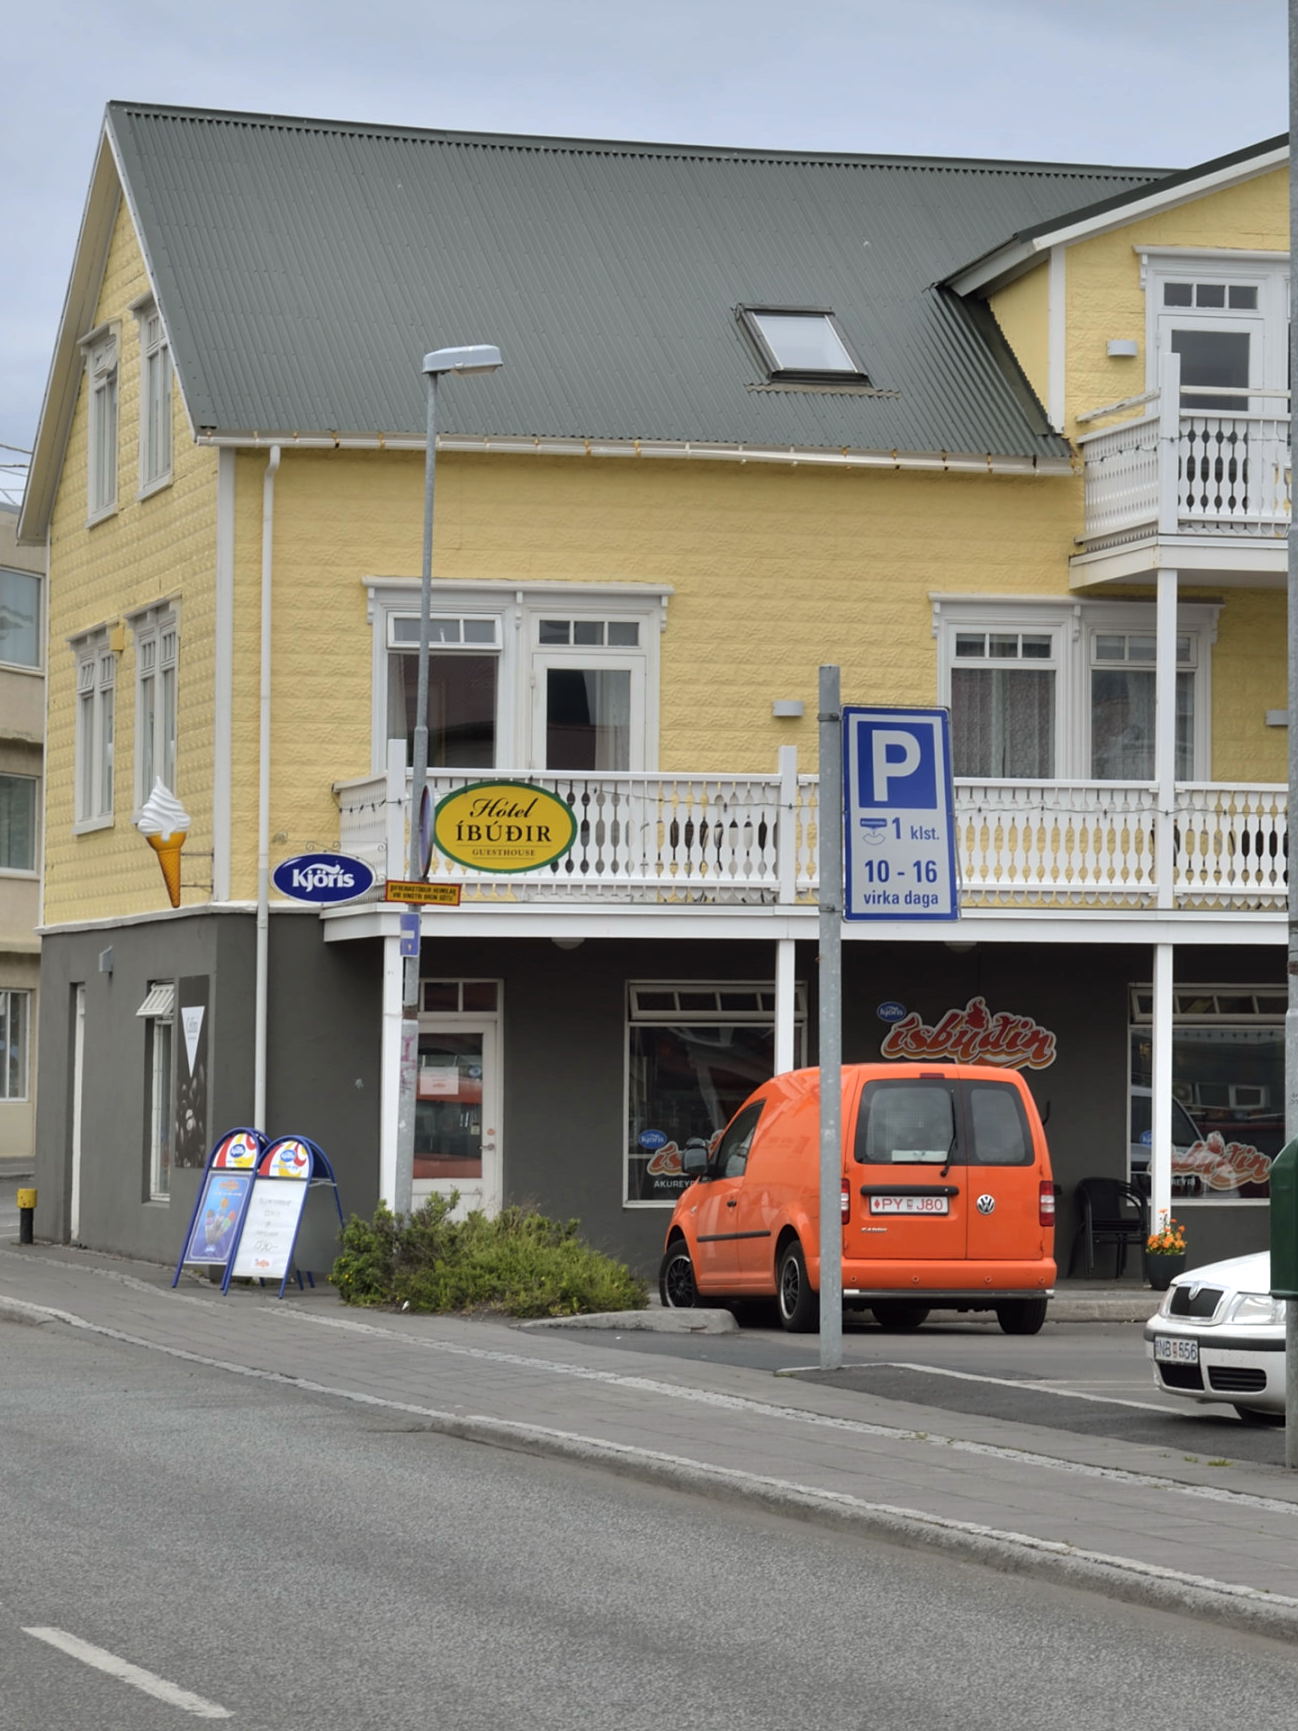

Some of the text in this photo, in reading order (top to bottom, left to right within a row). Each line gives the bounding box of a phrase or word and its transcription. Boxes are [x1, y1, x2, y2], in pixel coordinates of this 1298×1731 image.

[872, 729, 921, 802] P
[469, 796, 539, 819] Hótel
[456, 820, 553, 842] ÍBÚÐIR
[891, 816, 941, 841] 1 klst.
[472, 848, 535, 857] GUESTHOUSE
[291, 865, 355, 892] Kjörís
[864, 859, 890, 883] 10
[913, 859, 938, 884] 16
[863, 890, 939, 908] virka daga
[882, 1198, 944, 1211] PY J80
